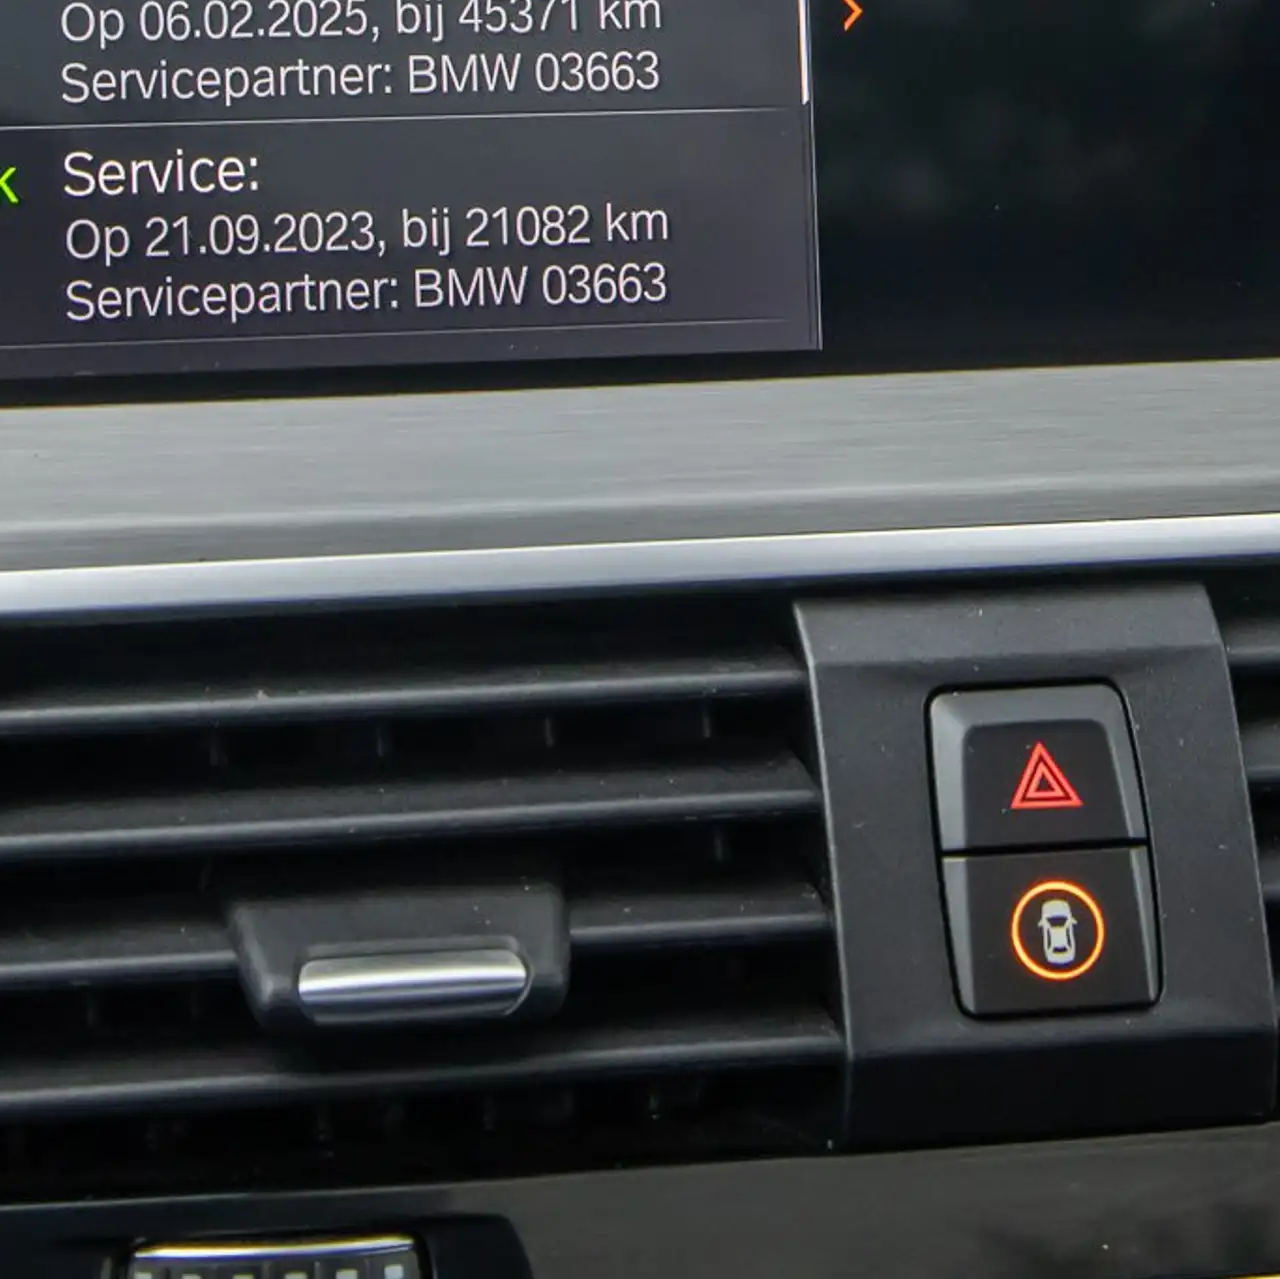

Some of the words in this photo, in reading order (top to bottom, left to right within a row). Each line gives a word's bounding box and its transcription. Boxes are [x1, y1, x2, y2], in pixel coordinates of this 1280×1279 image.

[61, 2, 125, 50] Op
[61, 58, 392, 107] Servicepartner:
[408, 52, 521, 93] BMW
[535, 50, 659, 92] 03663
[64, 148, 258, 197] Service:
[66, 219, 130, 267] Op
[145, 210, 385, 257] 21.09.2023,
[402, 207, 450, 256] bij
[466, 204, 591, 247] 21082
[606, 202, 668, 241] km
[66, 273, 398, 323] Servicepartner:
[414, 265, 529, 307] BMW
[542, 262, 666, 305] 03663
